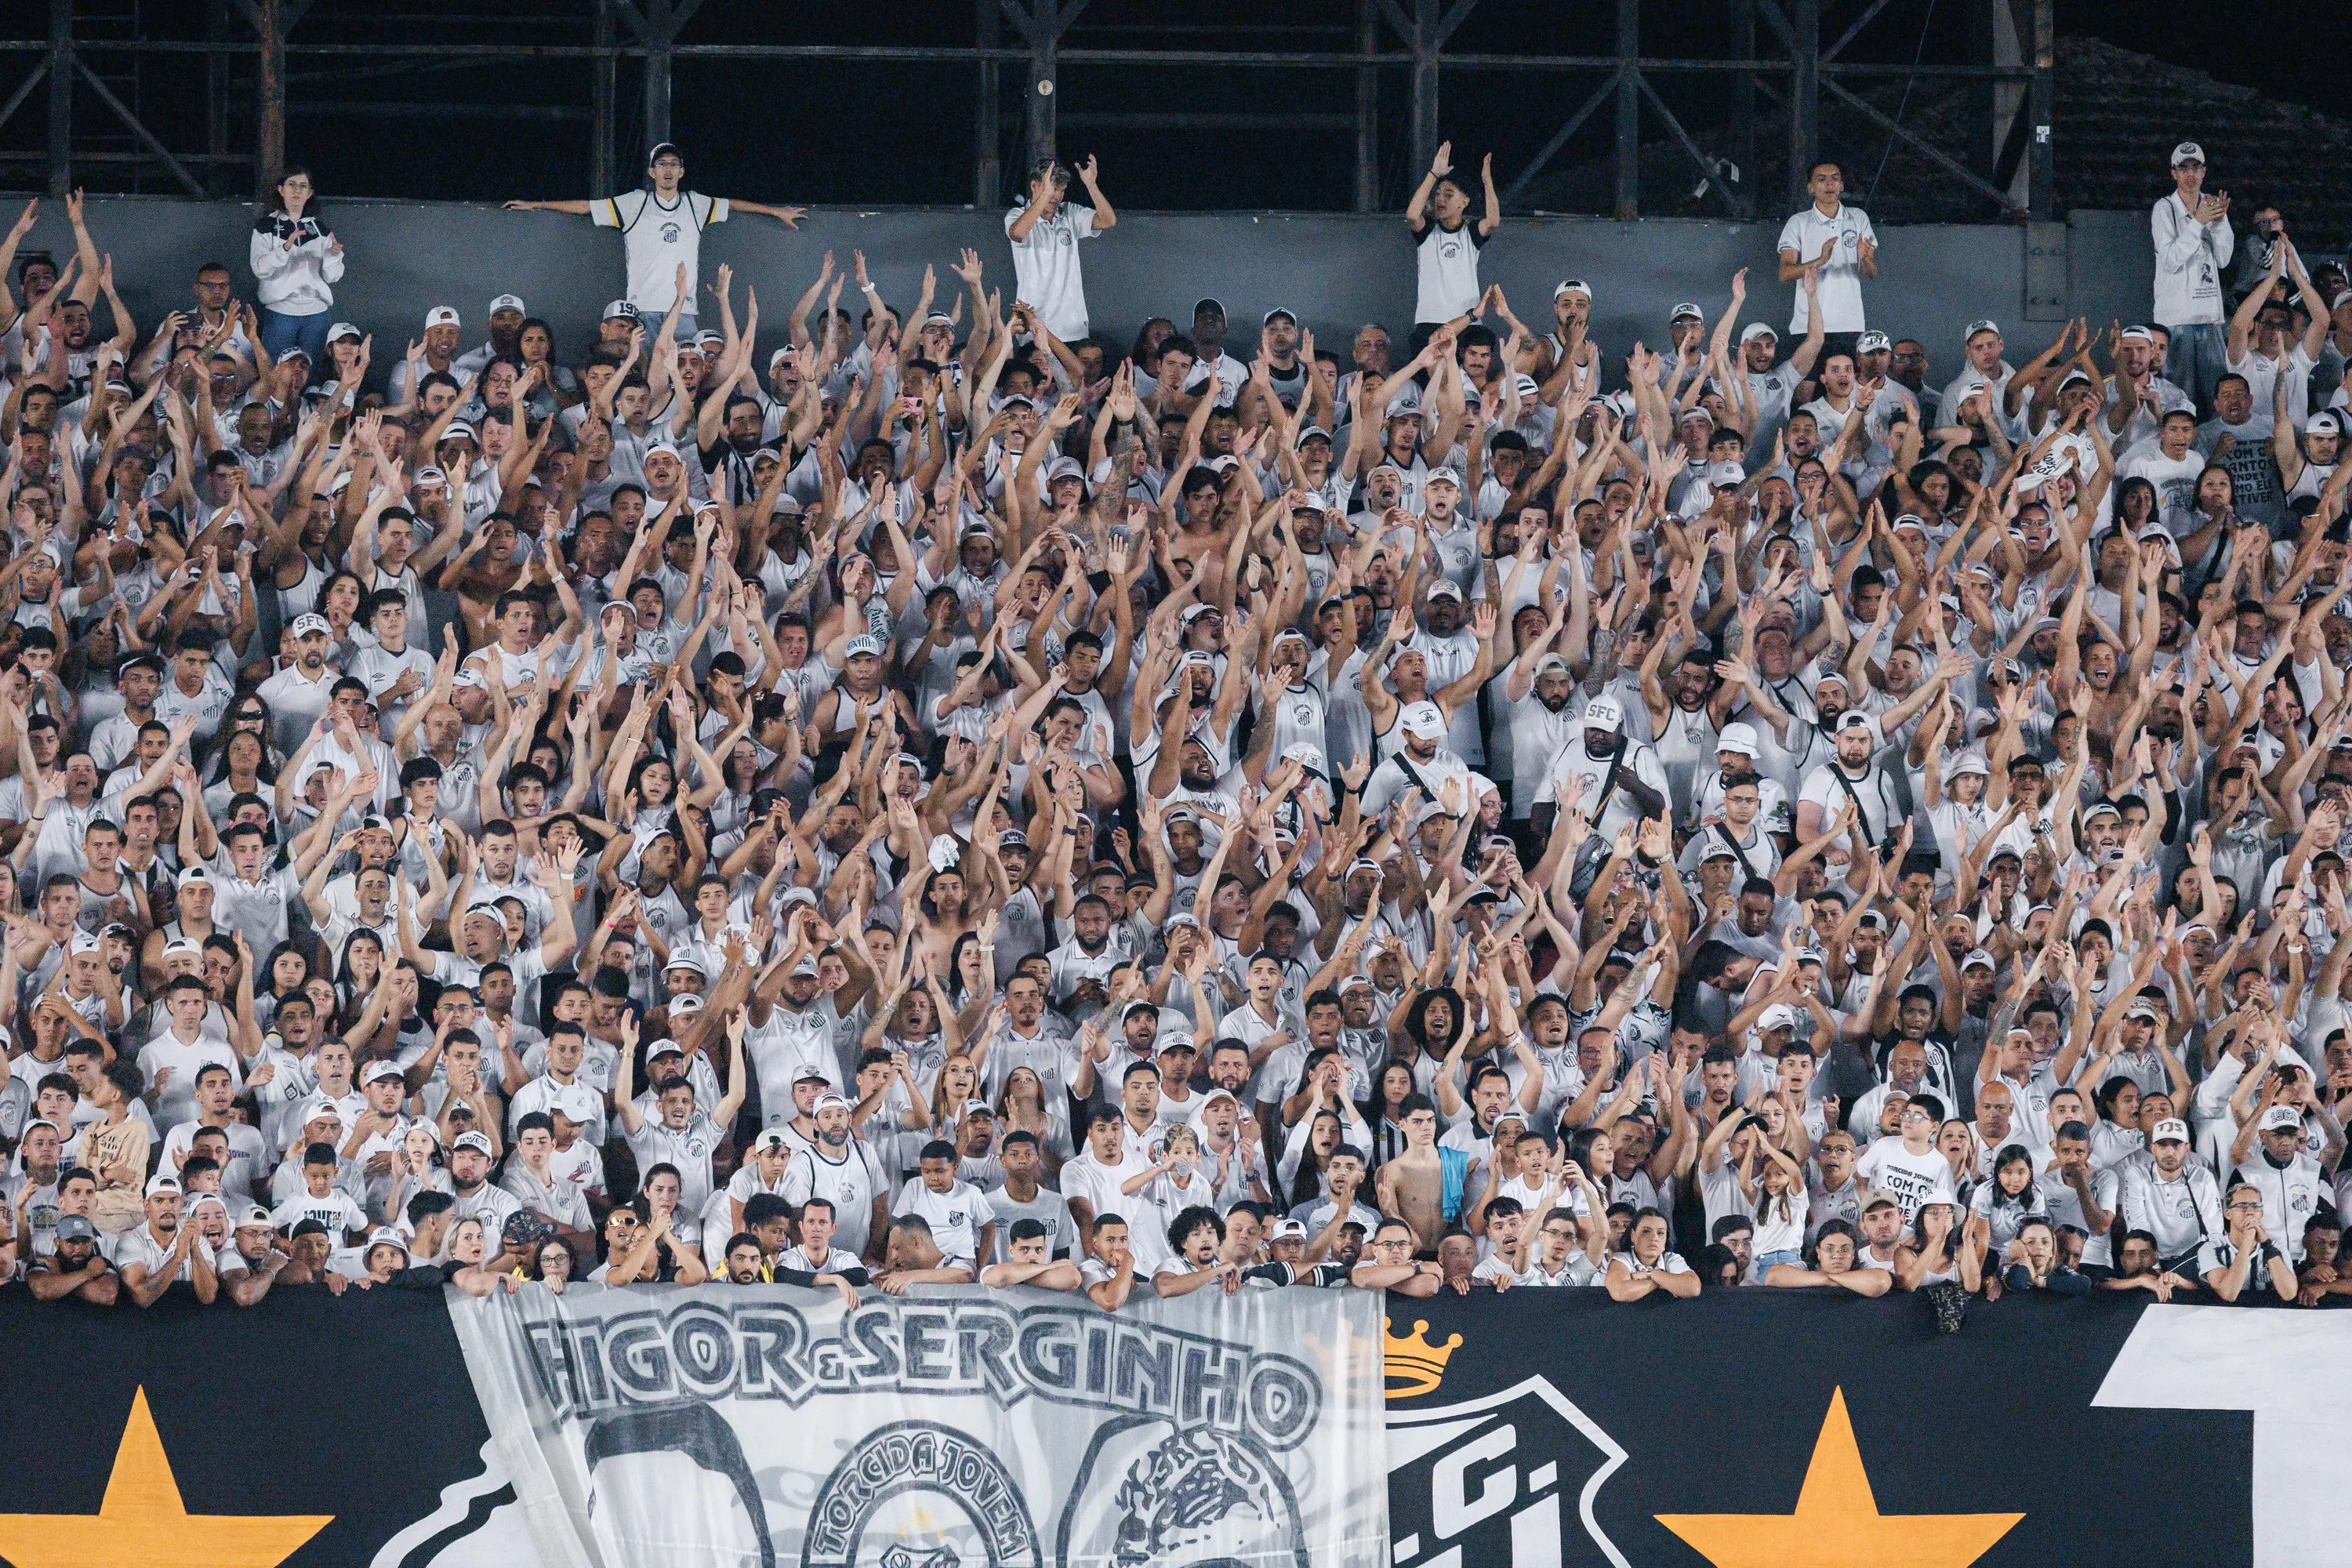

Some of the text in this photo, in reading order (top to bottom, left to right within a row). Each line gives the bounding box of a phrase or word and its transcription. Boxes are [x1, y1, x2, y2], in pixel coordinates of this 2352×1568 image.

[297, 615, 323, 630] SFC
[1588, 704, 1615, 721] SFC
[2270, 1109, 2298, 1124] 1969
[2158, 1121, 2183, 1133] TJS
[1887, 1175, 1914, 1192] COM
[813, 1432, 1029, 1560] TORCIDA JOVEM
